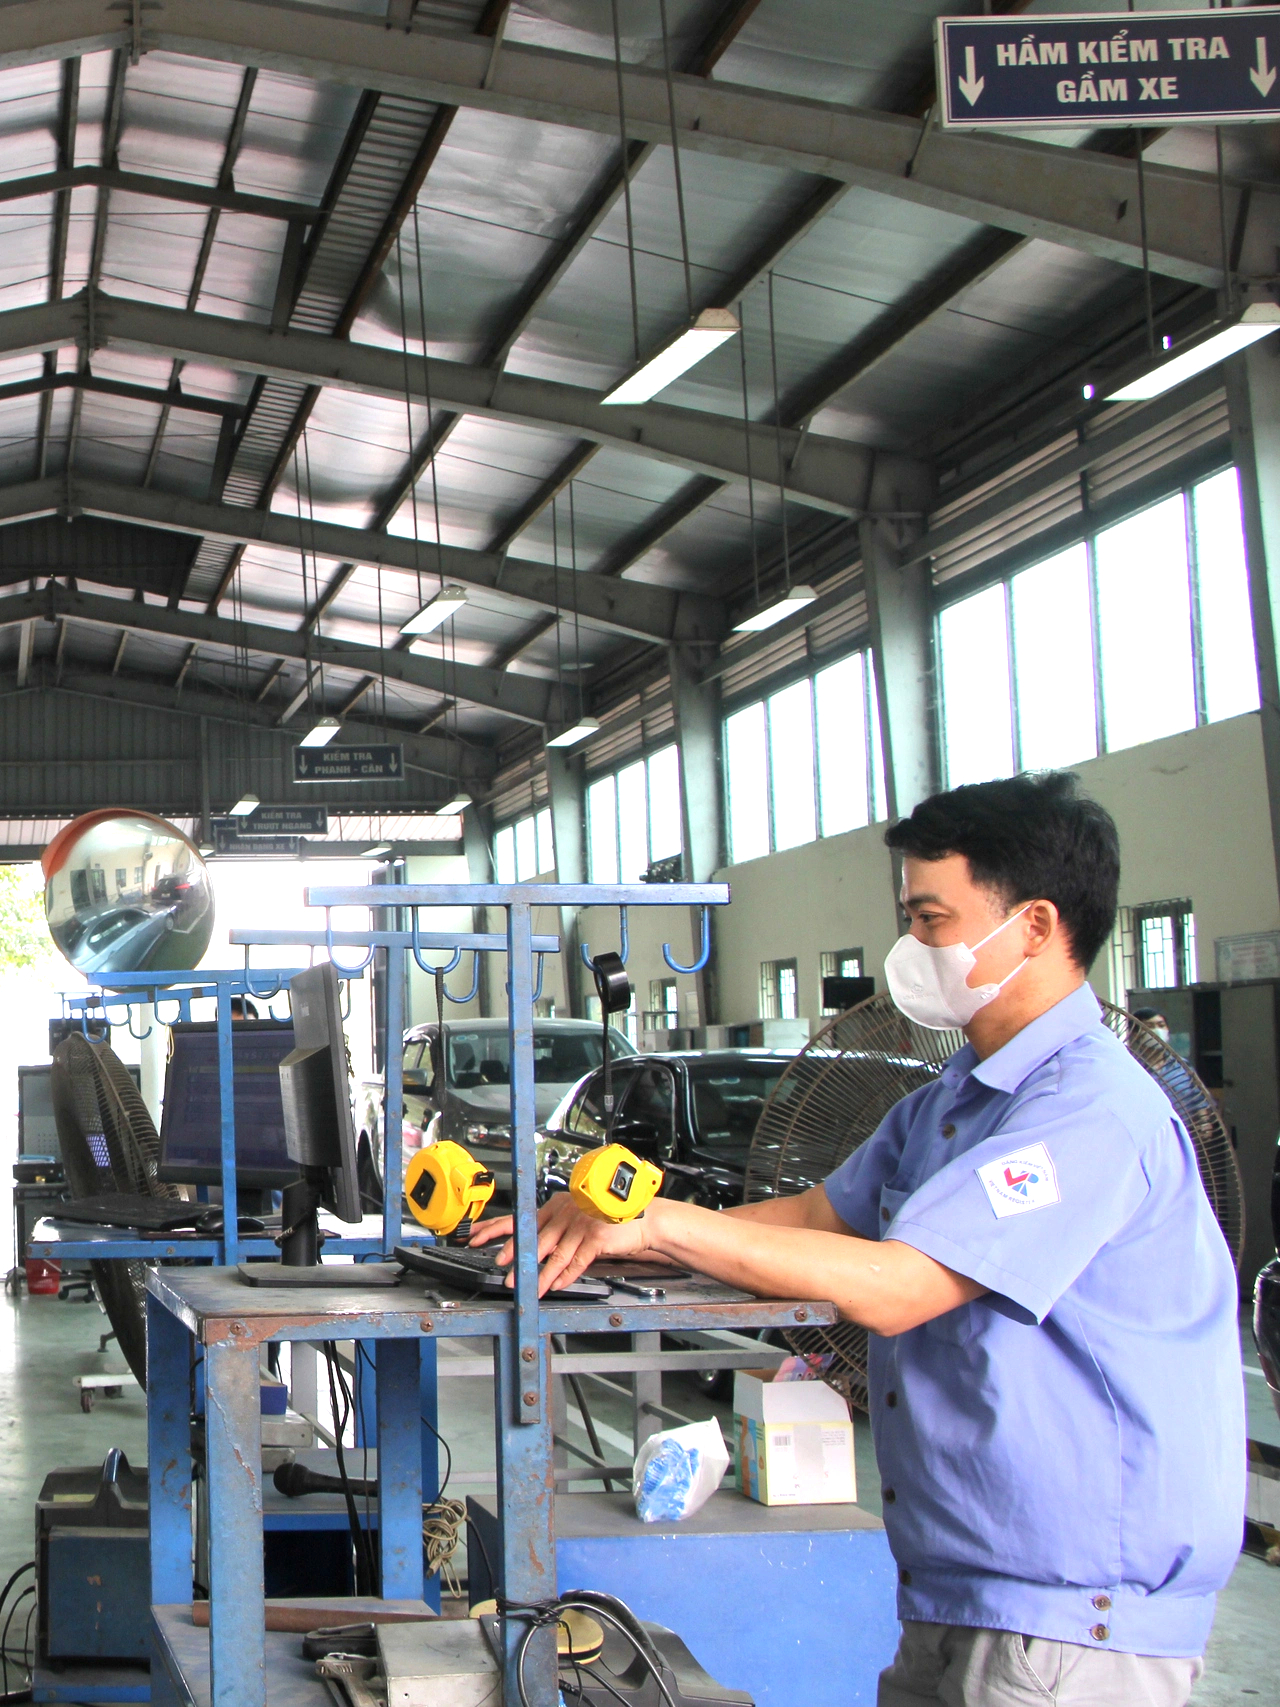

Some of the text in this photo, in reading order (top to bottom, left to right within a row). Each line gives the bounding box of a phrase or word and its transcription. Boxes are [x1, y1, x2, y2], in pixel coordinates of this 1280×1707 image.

[996, 29, 1230, 66] HẦM KIỂM TRA
[1056, 71, 1179, 103] GẦM XE
[323, 749, 373, 761] KIỂM TRA
[315, 765, 351, 774] PHANH
[282, 822, 312, 830] NGANG
